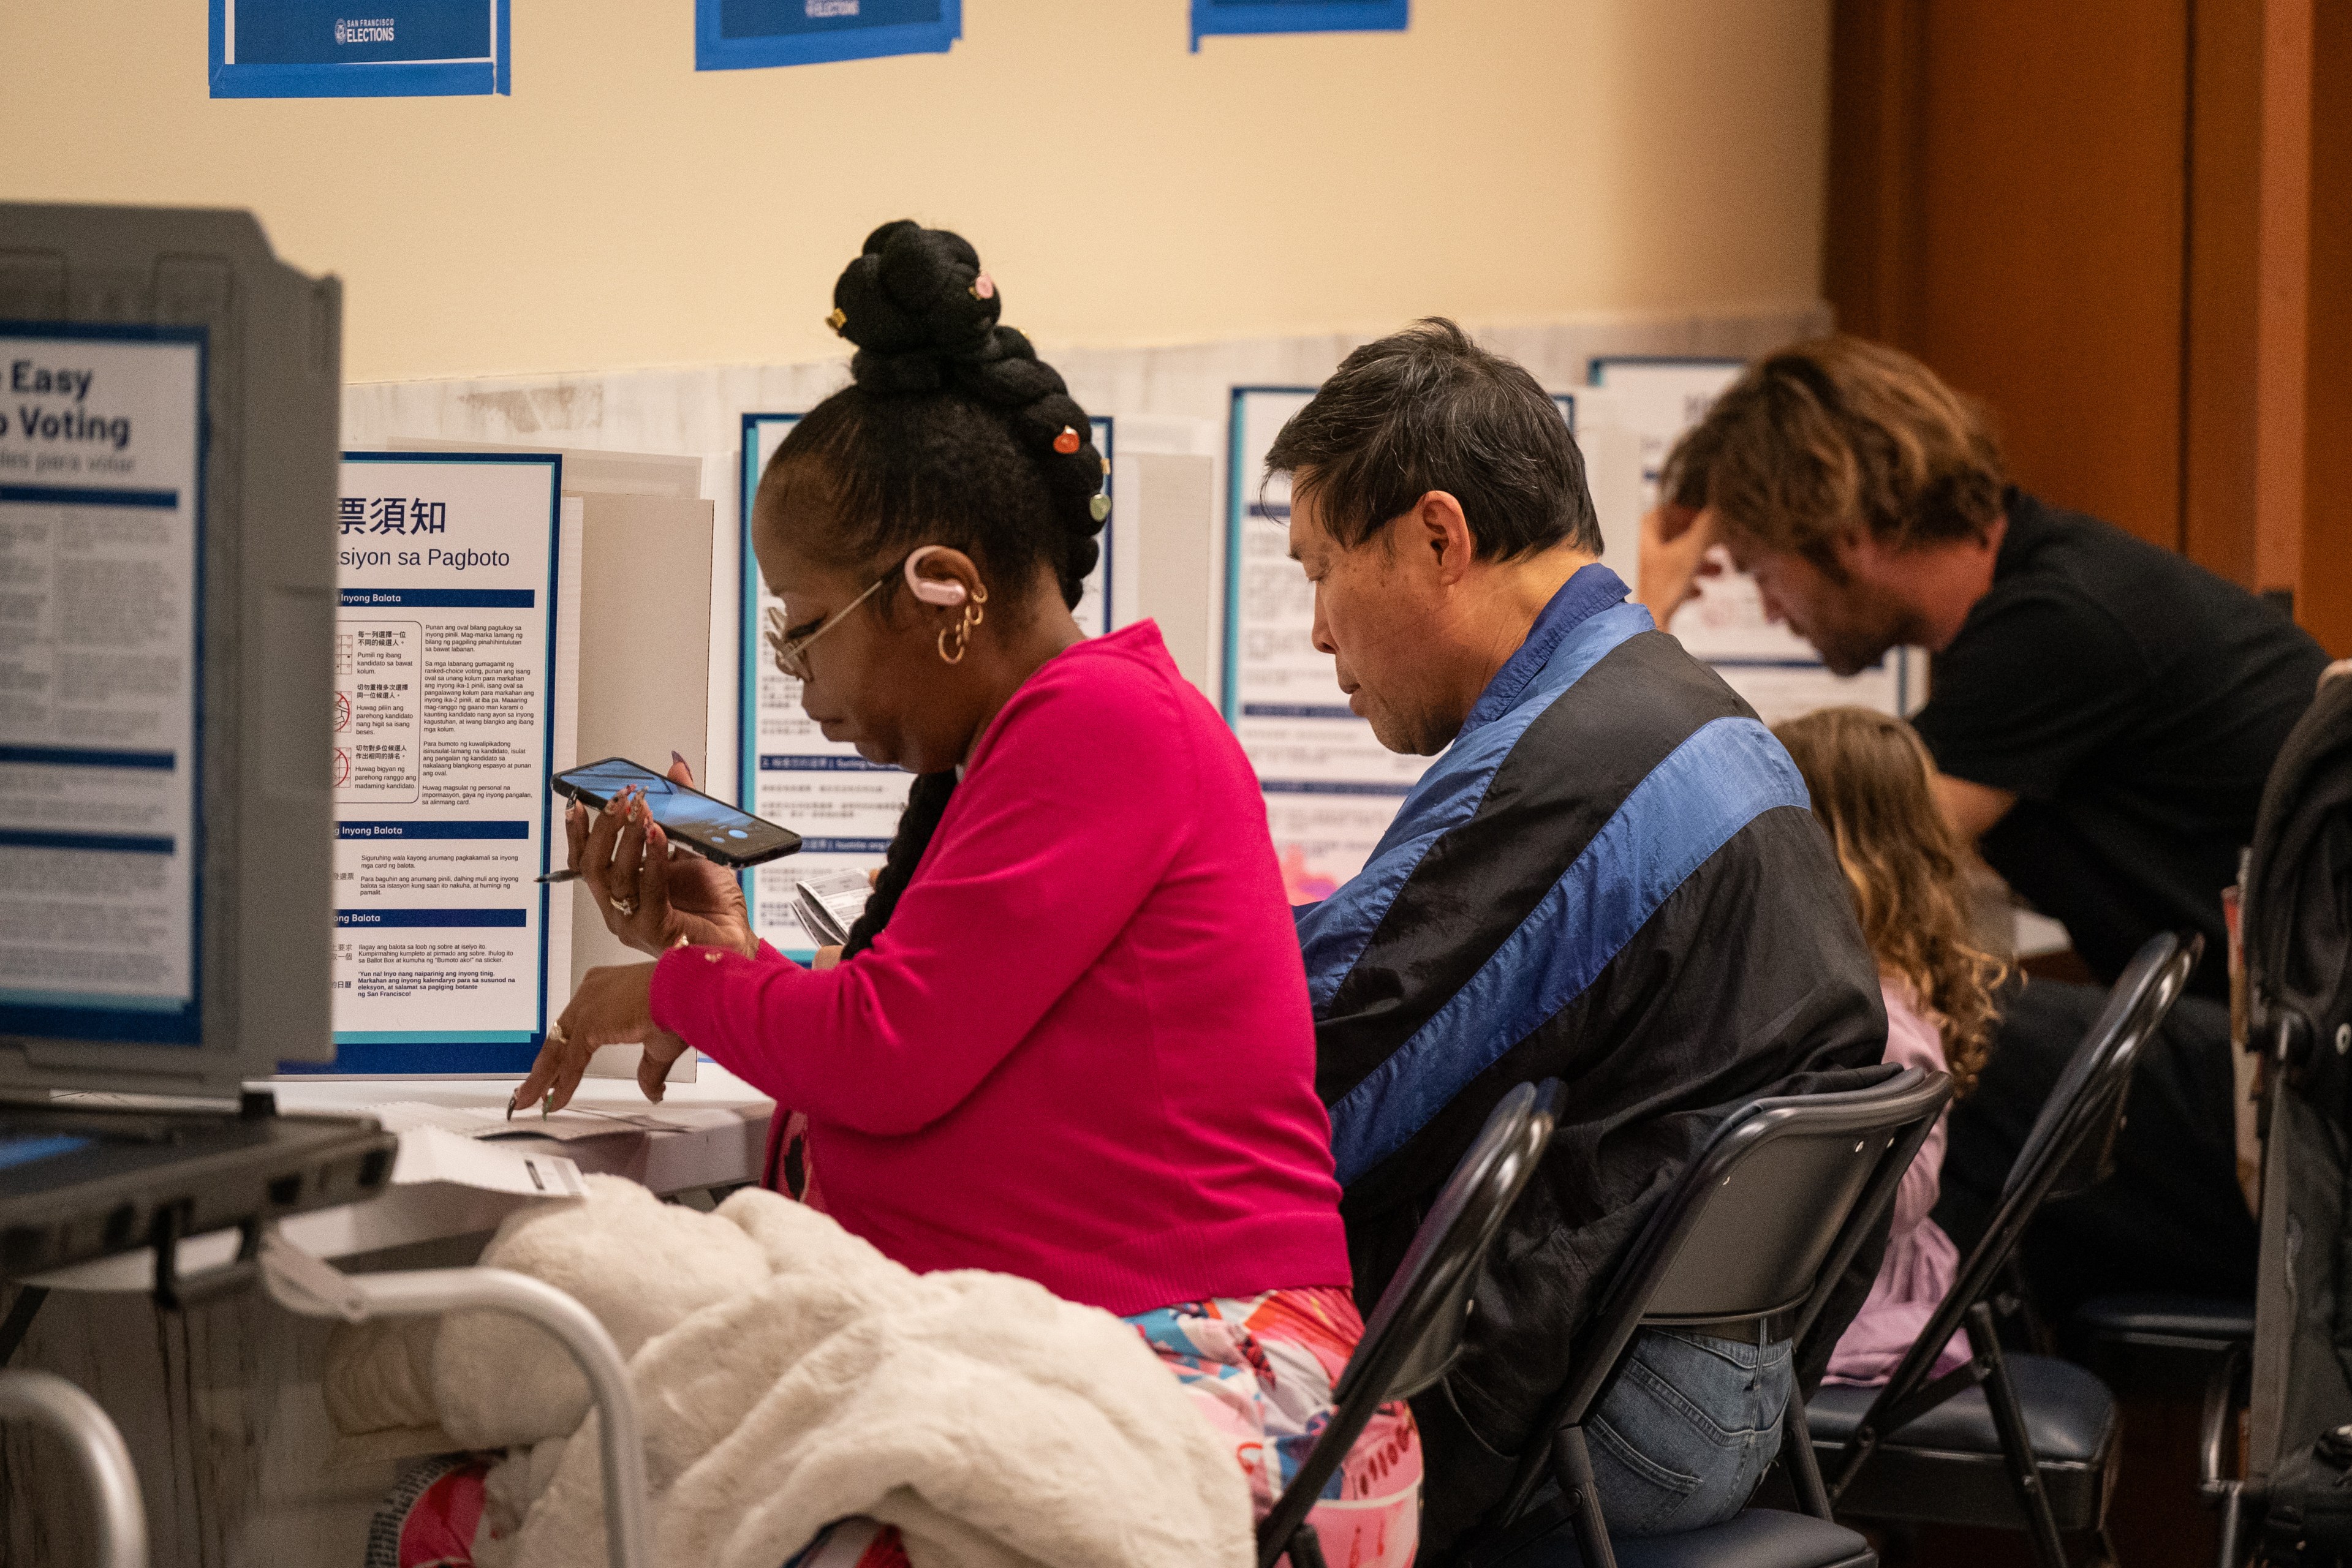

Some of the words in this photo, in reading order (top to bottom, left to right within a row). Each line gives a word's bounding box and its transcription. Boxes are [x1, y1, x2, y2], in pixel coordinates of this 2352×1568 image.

[347, 27, 394, 42] ELECTIONS
[12, 360, 93, 402] Easy
[20, 404, 130, 449] Voting
[338, 497, 446, 535] 票須知
[340, 547, 391, 570] siyon
[398, 552, 421, 565] sa
[428, 548, 510, 570] Pagboto
[341, 594, 370, 603] Inyong
[372, 594, 401, 602] Balota
[342, 826, 371, 836] Inyong
[333, 915, 349, 924] ong
